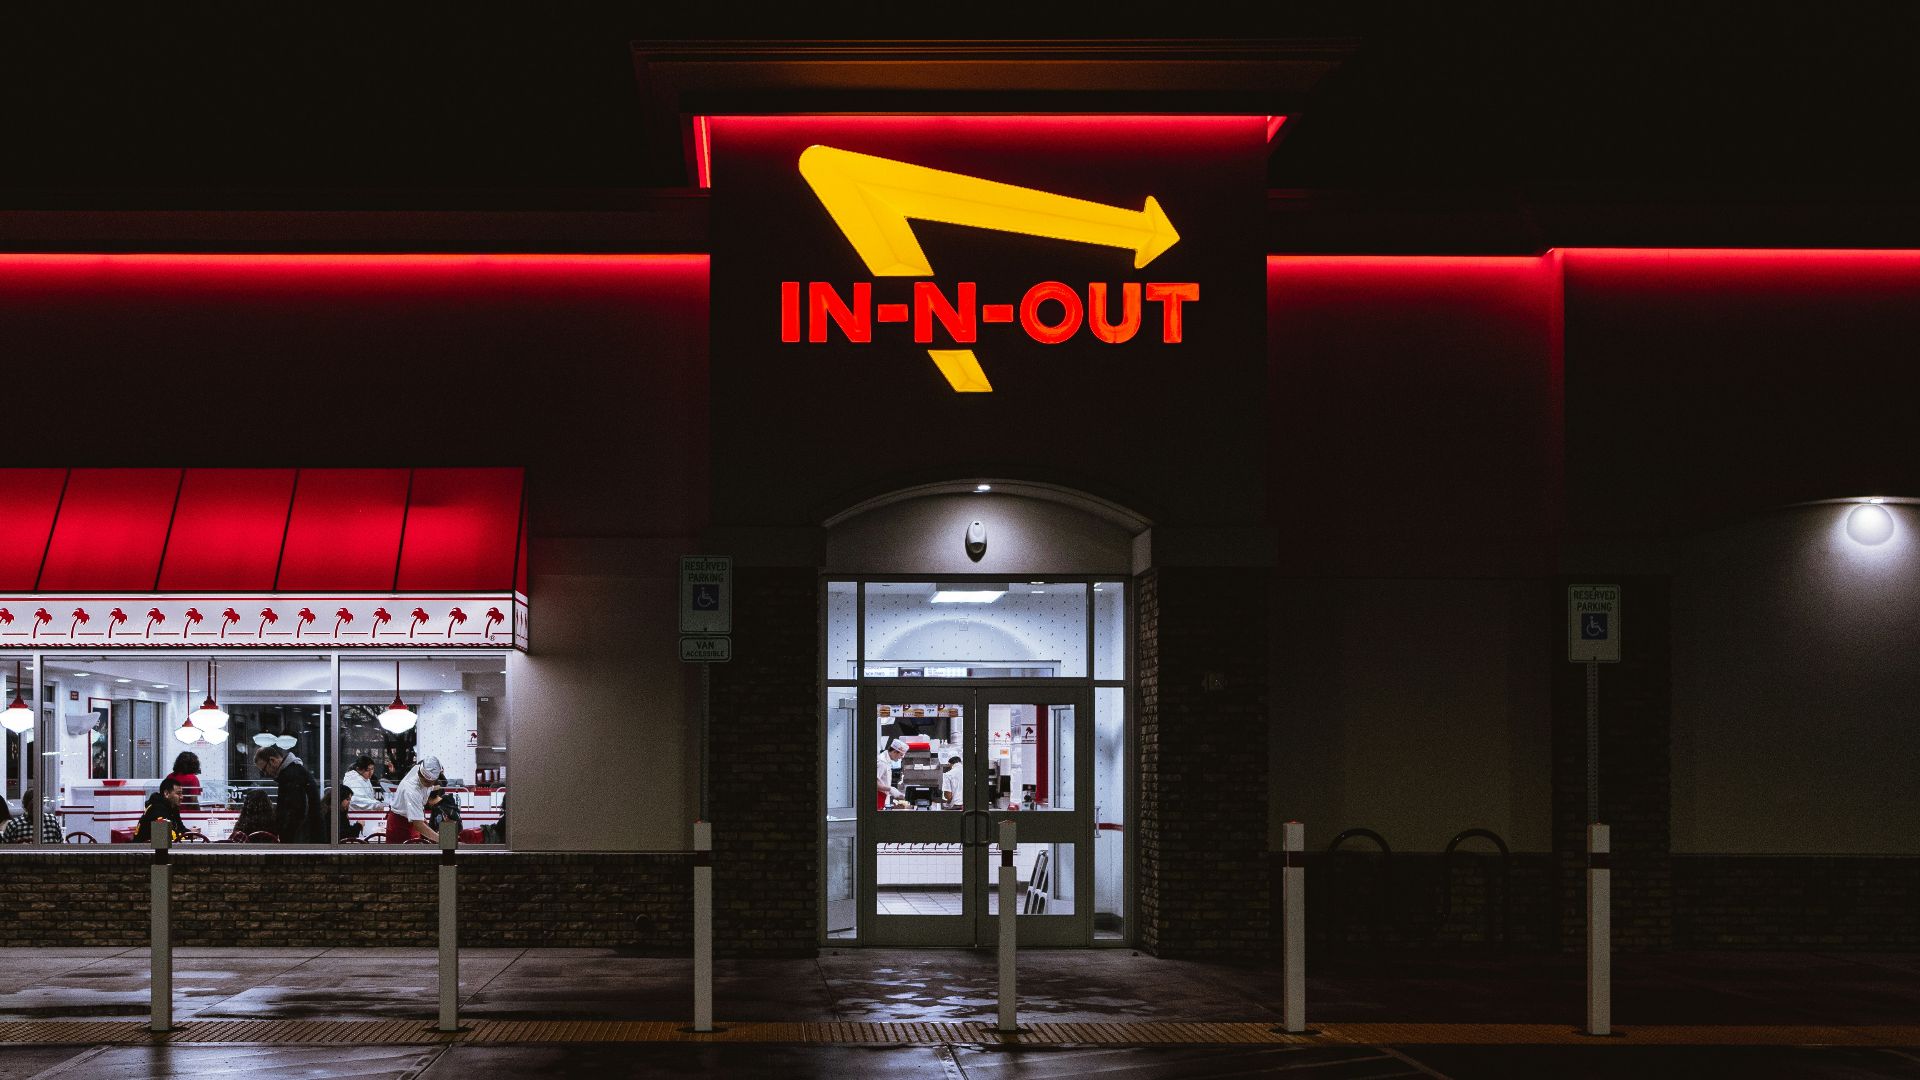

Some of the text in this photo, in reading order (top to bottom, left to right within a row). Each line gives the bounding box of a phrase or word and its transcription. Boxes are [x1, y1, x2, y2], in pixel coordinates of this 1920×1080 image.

[781, 281, 1200, 344] IN-N-OUT
[684, 561, 727, 571] RESERVED
[688, 573, 724, 582] PARKING
[1573, 591, 1616, 600] RESERVED
[1577, 602, 1612, 611] PARKING
[696, 641, 715, 650] VAN
